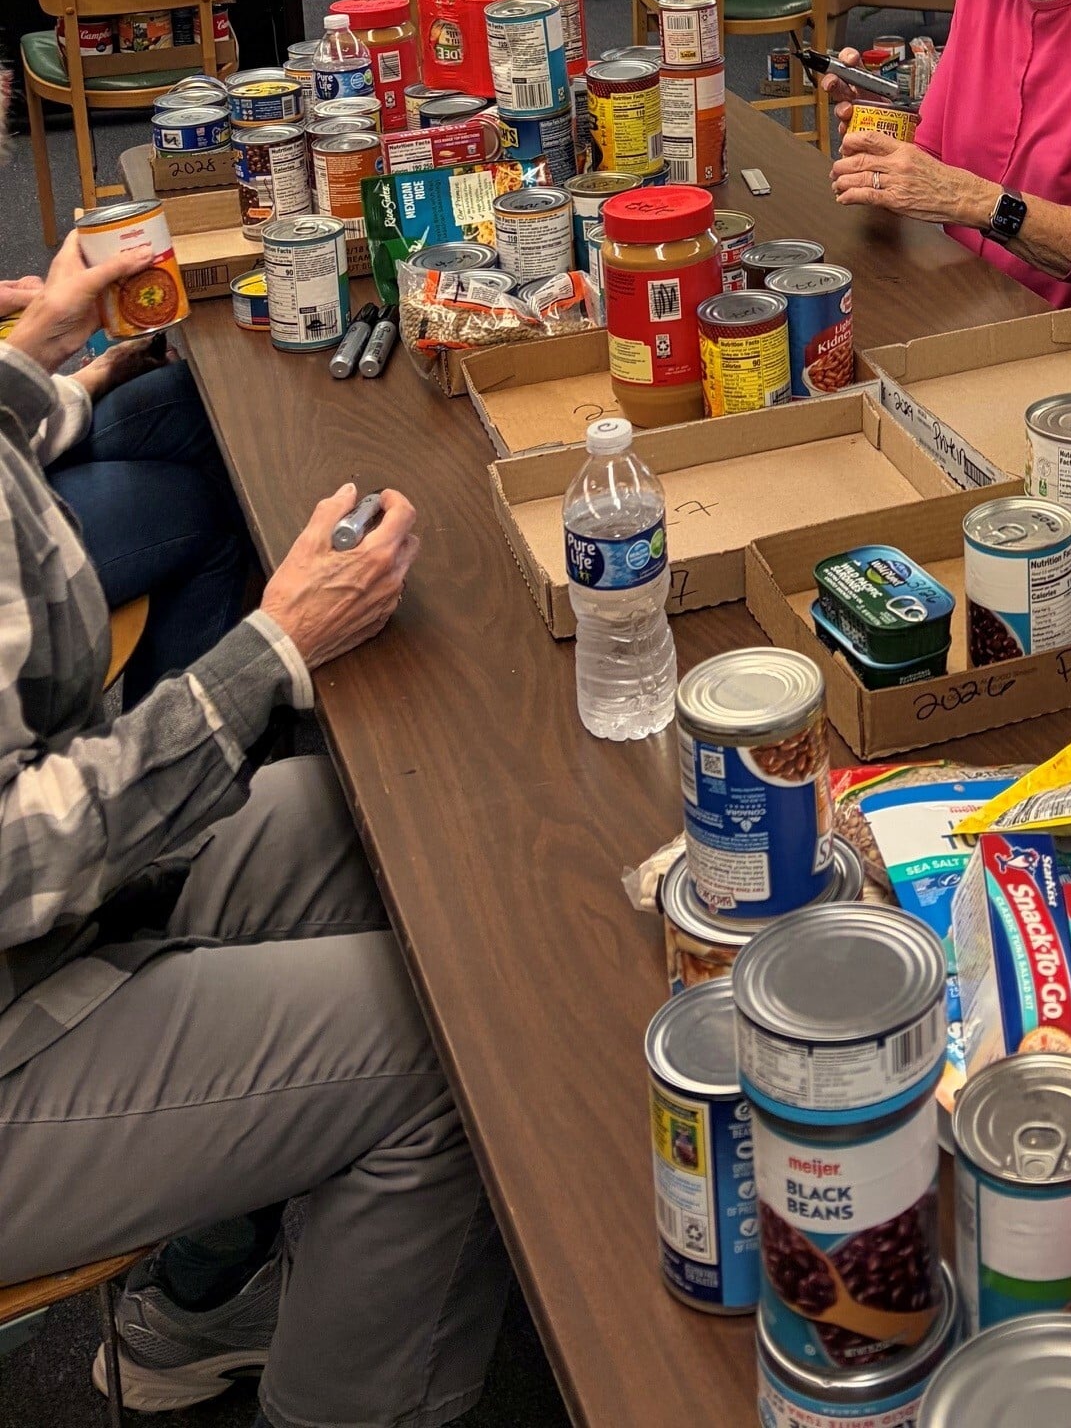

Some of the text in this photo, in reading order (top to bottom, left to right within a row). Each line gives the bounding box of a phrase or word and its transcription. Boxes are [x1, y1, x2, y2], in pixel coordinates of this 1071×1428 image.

[316, 72, 334, 84] Pure
[317, 81, 333, 93] Life
[413, 180, 426, 200] RICE
[401, 182, 416, 220] MEXICAN
[568, 533, 596, 556] Pure
[570, 550, 592, 570] Life
[1030, 554, 1062, 570] Nutrition
[1031, 589, 1058, 602] Calories
[905, 856, 960, 877] SEA SALT
[1041, 854, 1058, 908] StarKist
[788, 1156, 842, 1179] meijer
[786, 1180, 853, 1202] BLACK
[786, 1199, 854, 1221] BEANS
